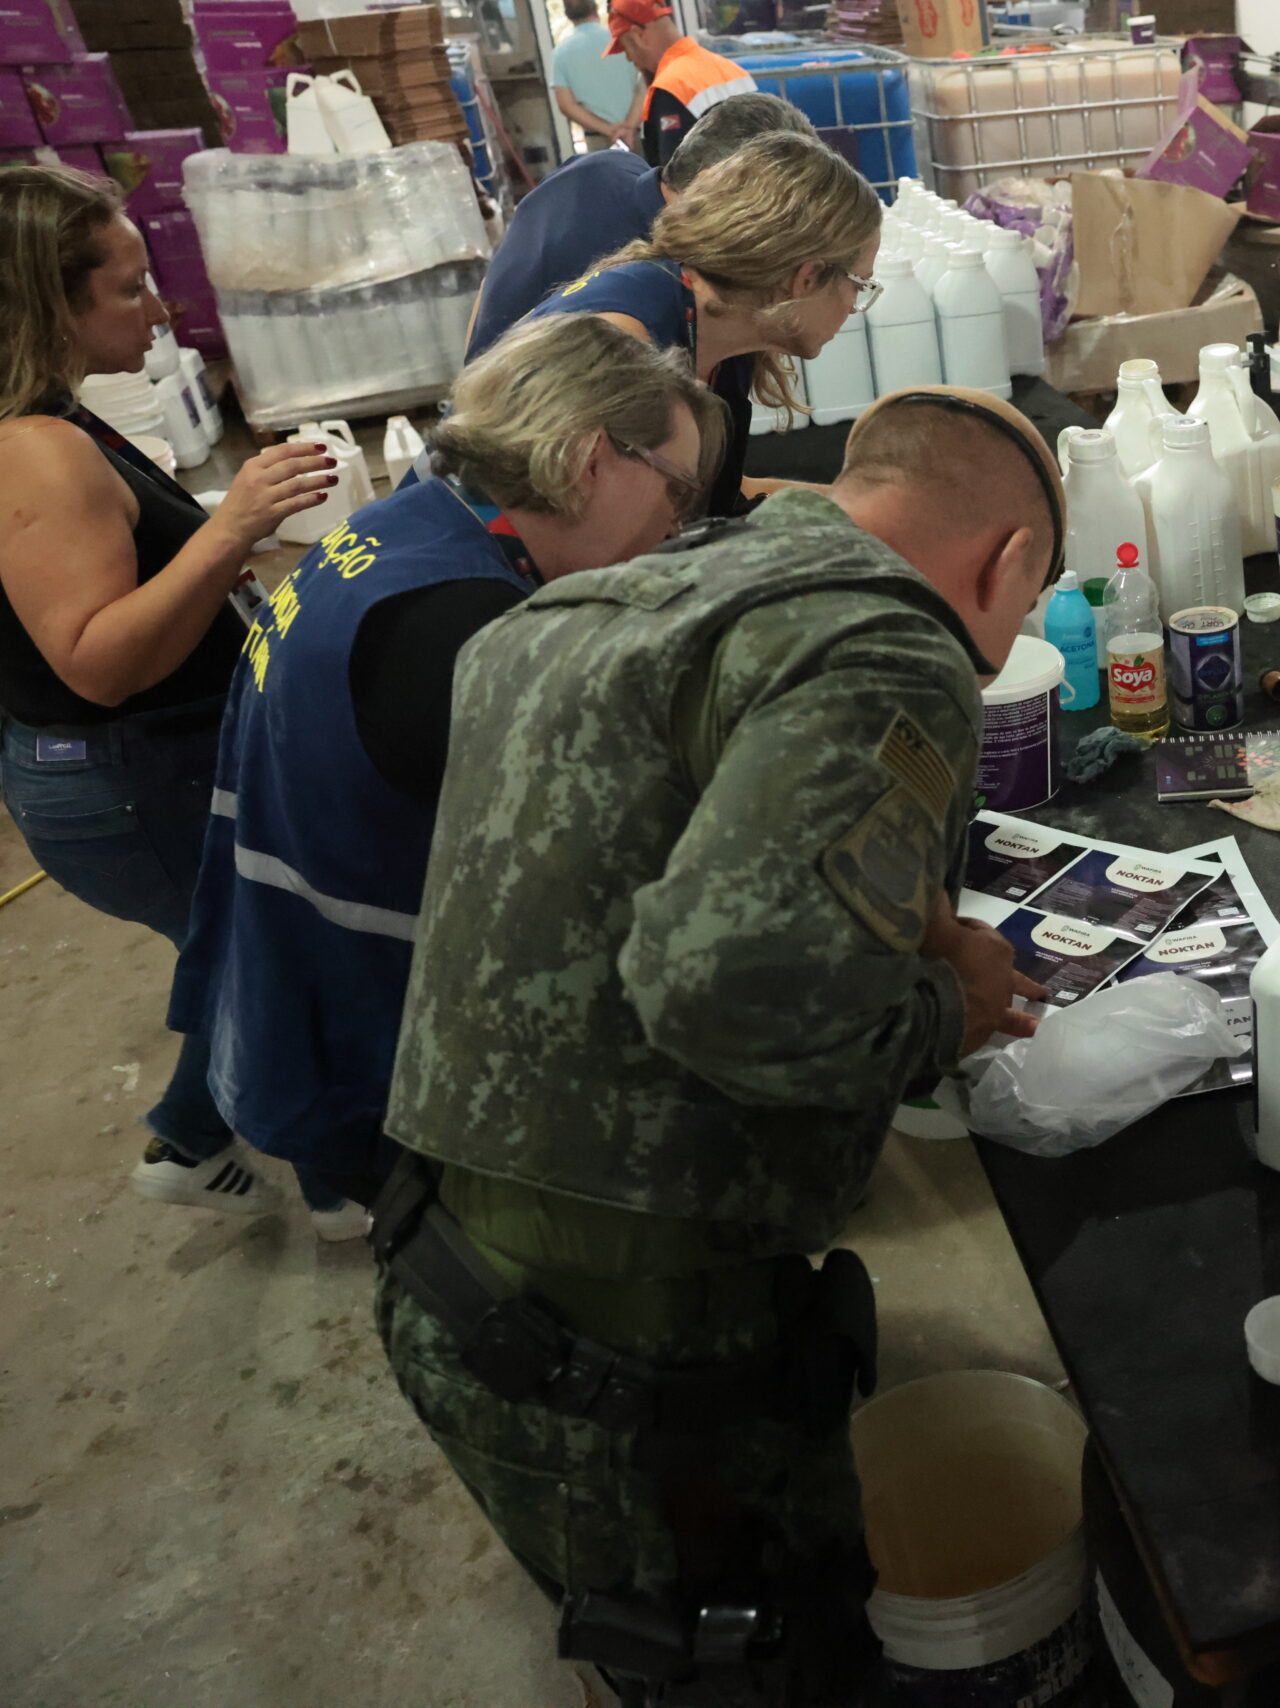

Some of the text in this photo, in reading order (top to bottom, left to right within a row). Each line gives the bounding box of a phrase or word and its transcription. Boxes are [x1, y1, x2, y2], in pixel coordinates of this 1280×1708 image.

[1113, 668, 1153, 687] Soya
[994, 838, 1040, 854] NOKTAN
[1115, 869, 1165, 886] NOKTAN
[1041, 931, 1093, 951] NOKTAN
[1157, 941, 1216, 957] NOKTAN
